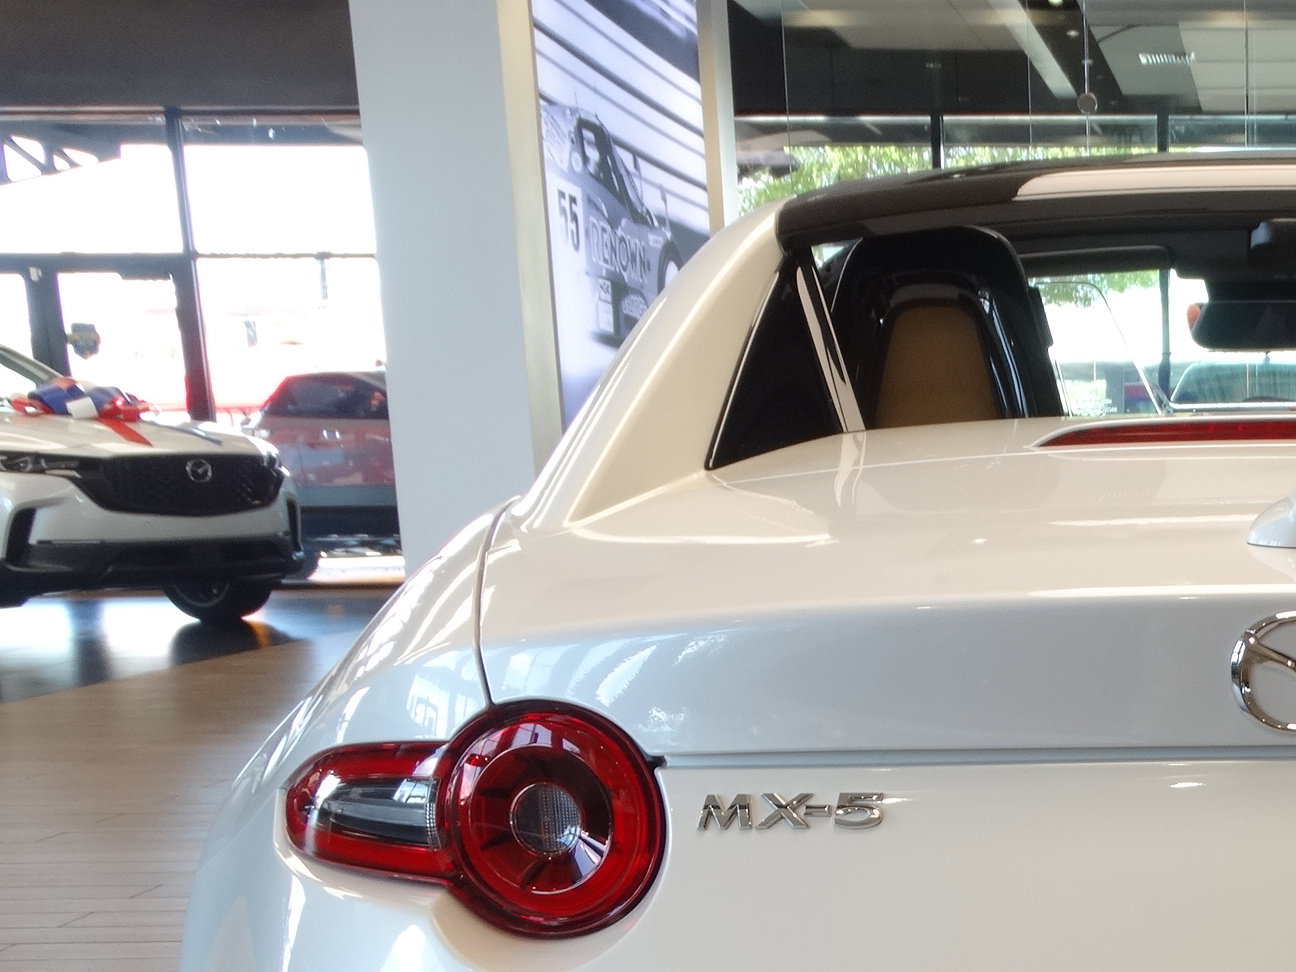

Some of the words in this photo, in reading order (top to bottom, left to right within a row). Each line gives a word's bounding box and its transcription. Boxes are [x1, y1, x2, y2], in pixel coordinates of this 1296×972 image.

[557, 189, 580, 252] 55
[588, 216, 649, 282] RENOWN
[697, 793, 884, 831] MX-5
